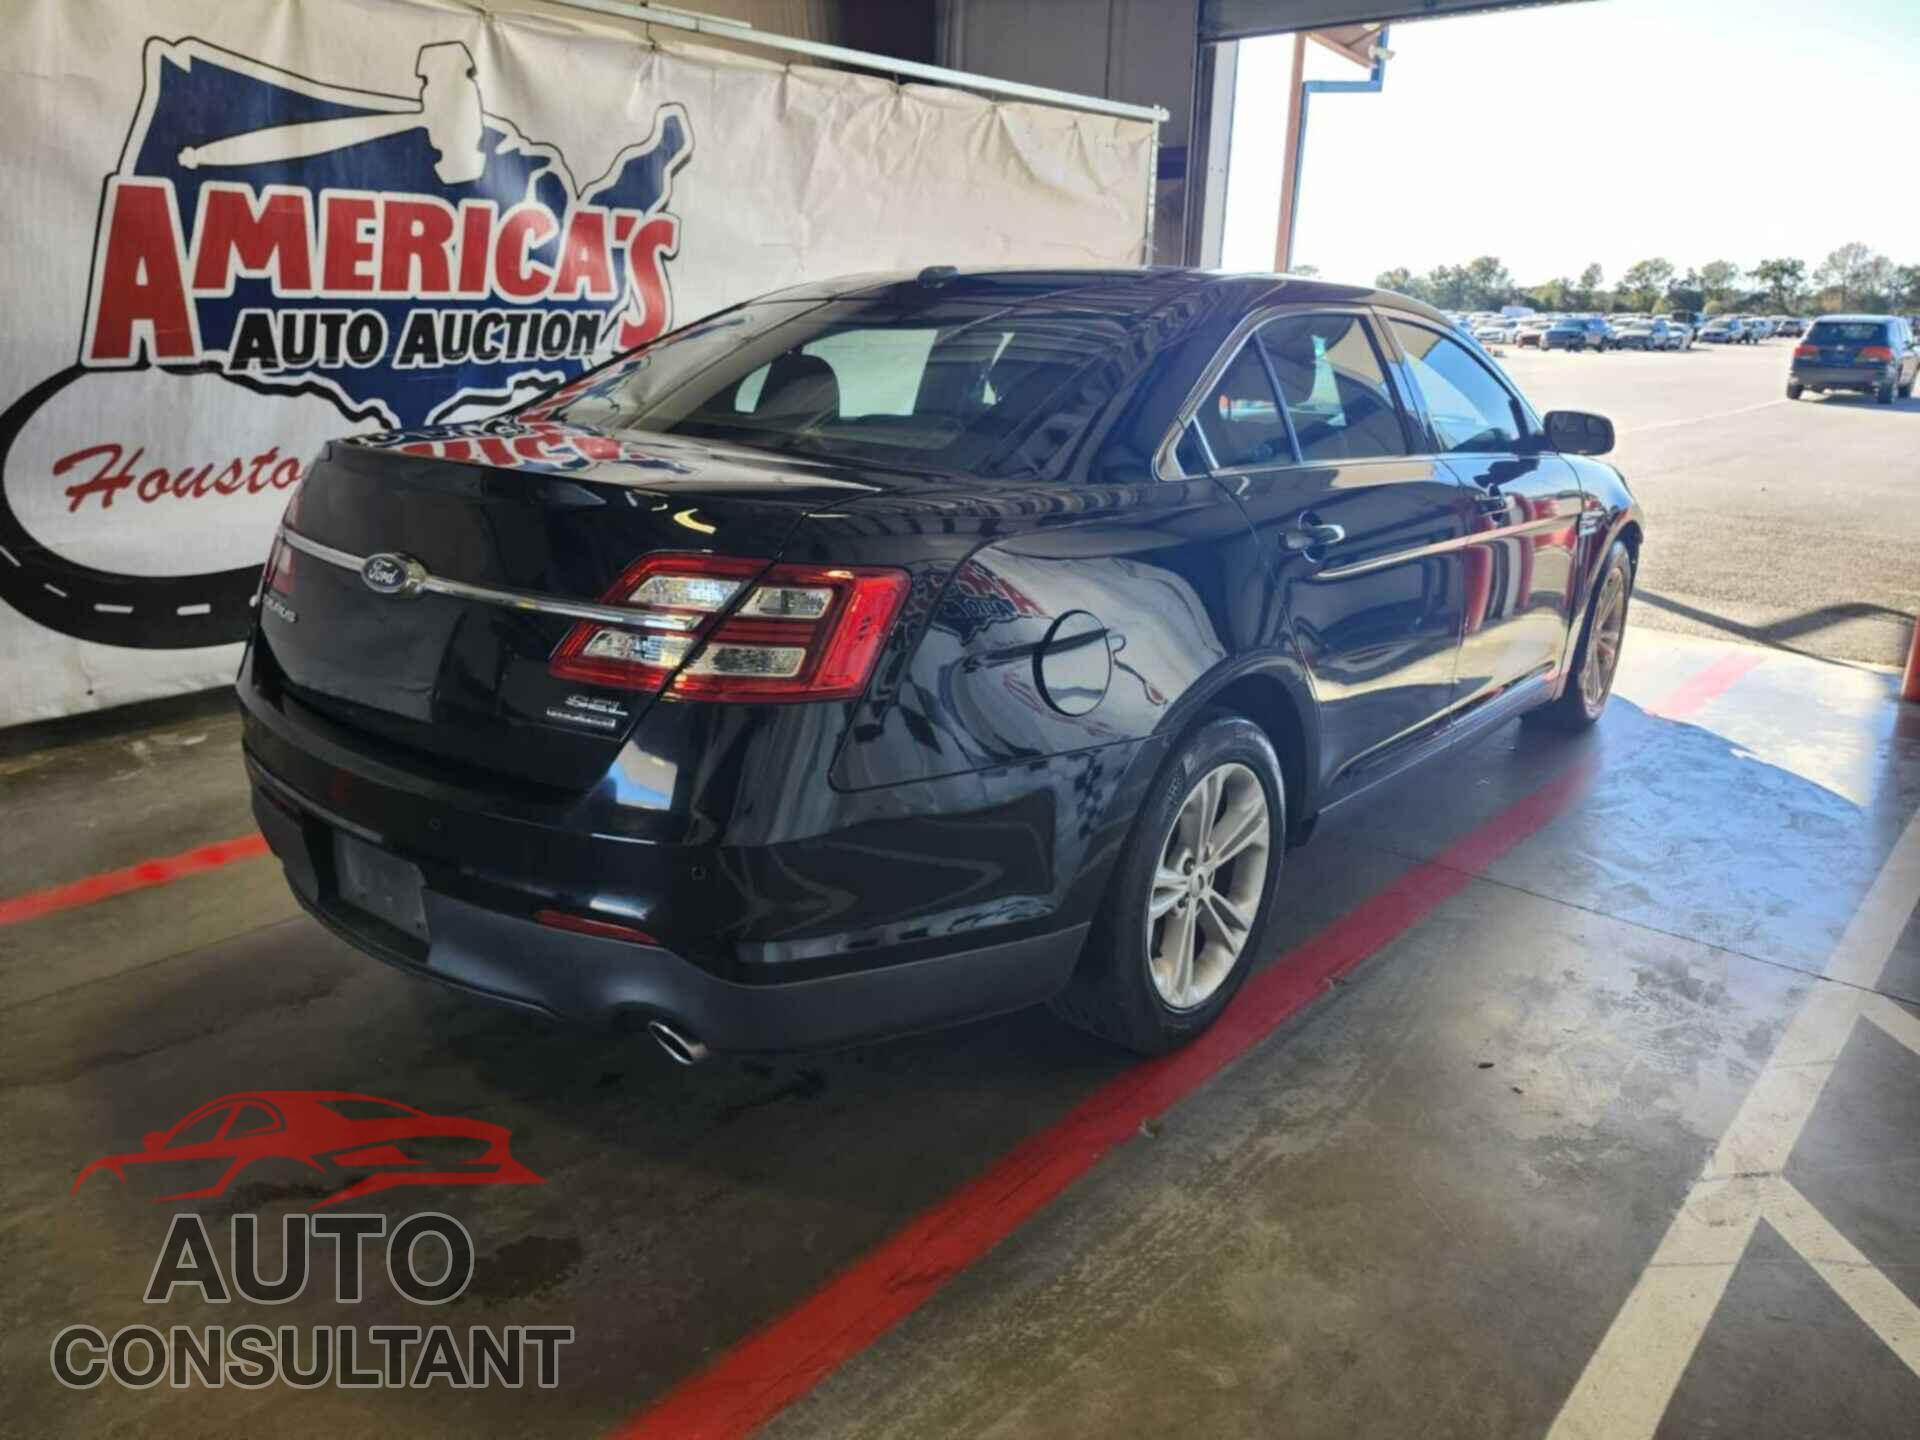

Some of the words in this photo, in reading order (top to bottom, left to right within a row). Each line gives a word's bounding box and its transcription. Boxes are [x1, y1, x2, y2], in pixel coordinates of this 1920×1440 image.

[90, 184, 674, 359] AMERICA'S
[229, 311, 384, 370] AUTO
[396, 312, 601, 366] AUCTION
[53, 443, 302, 513] Housto
